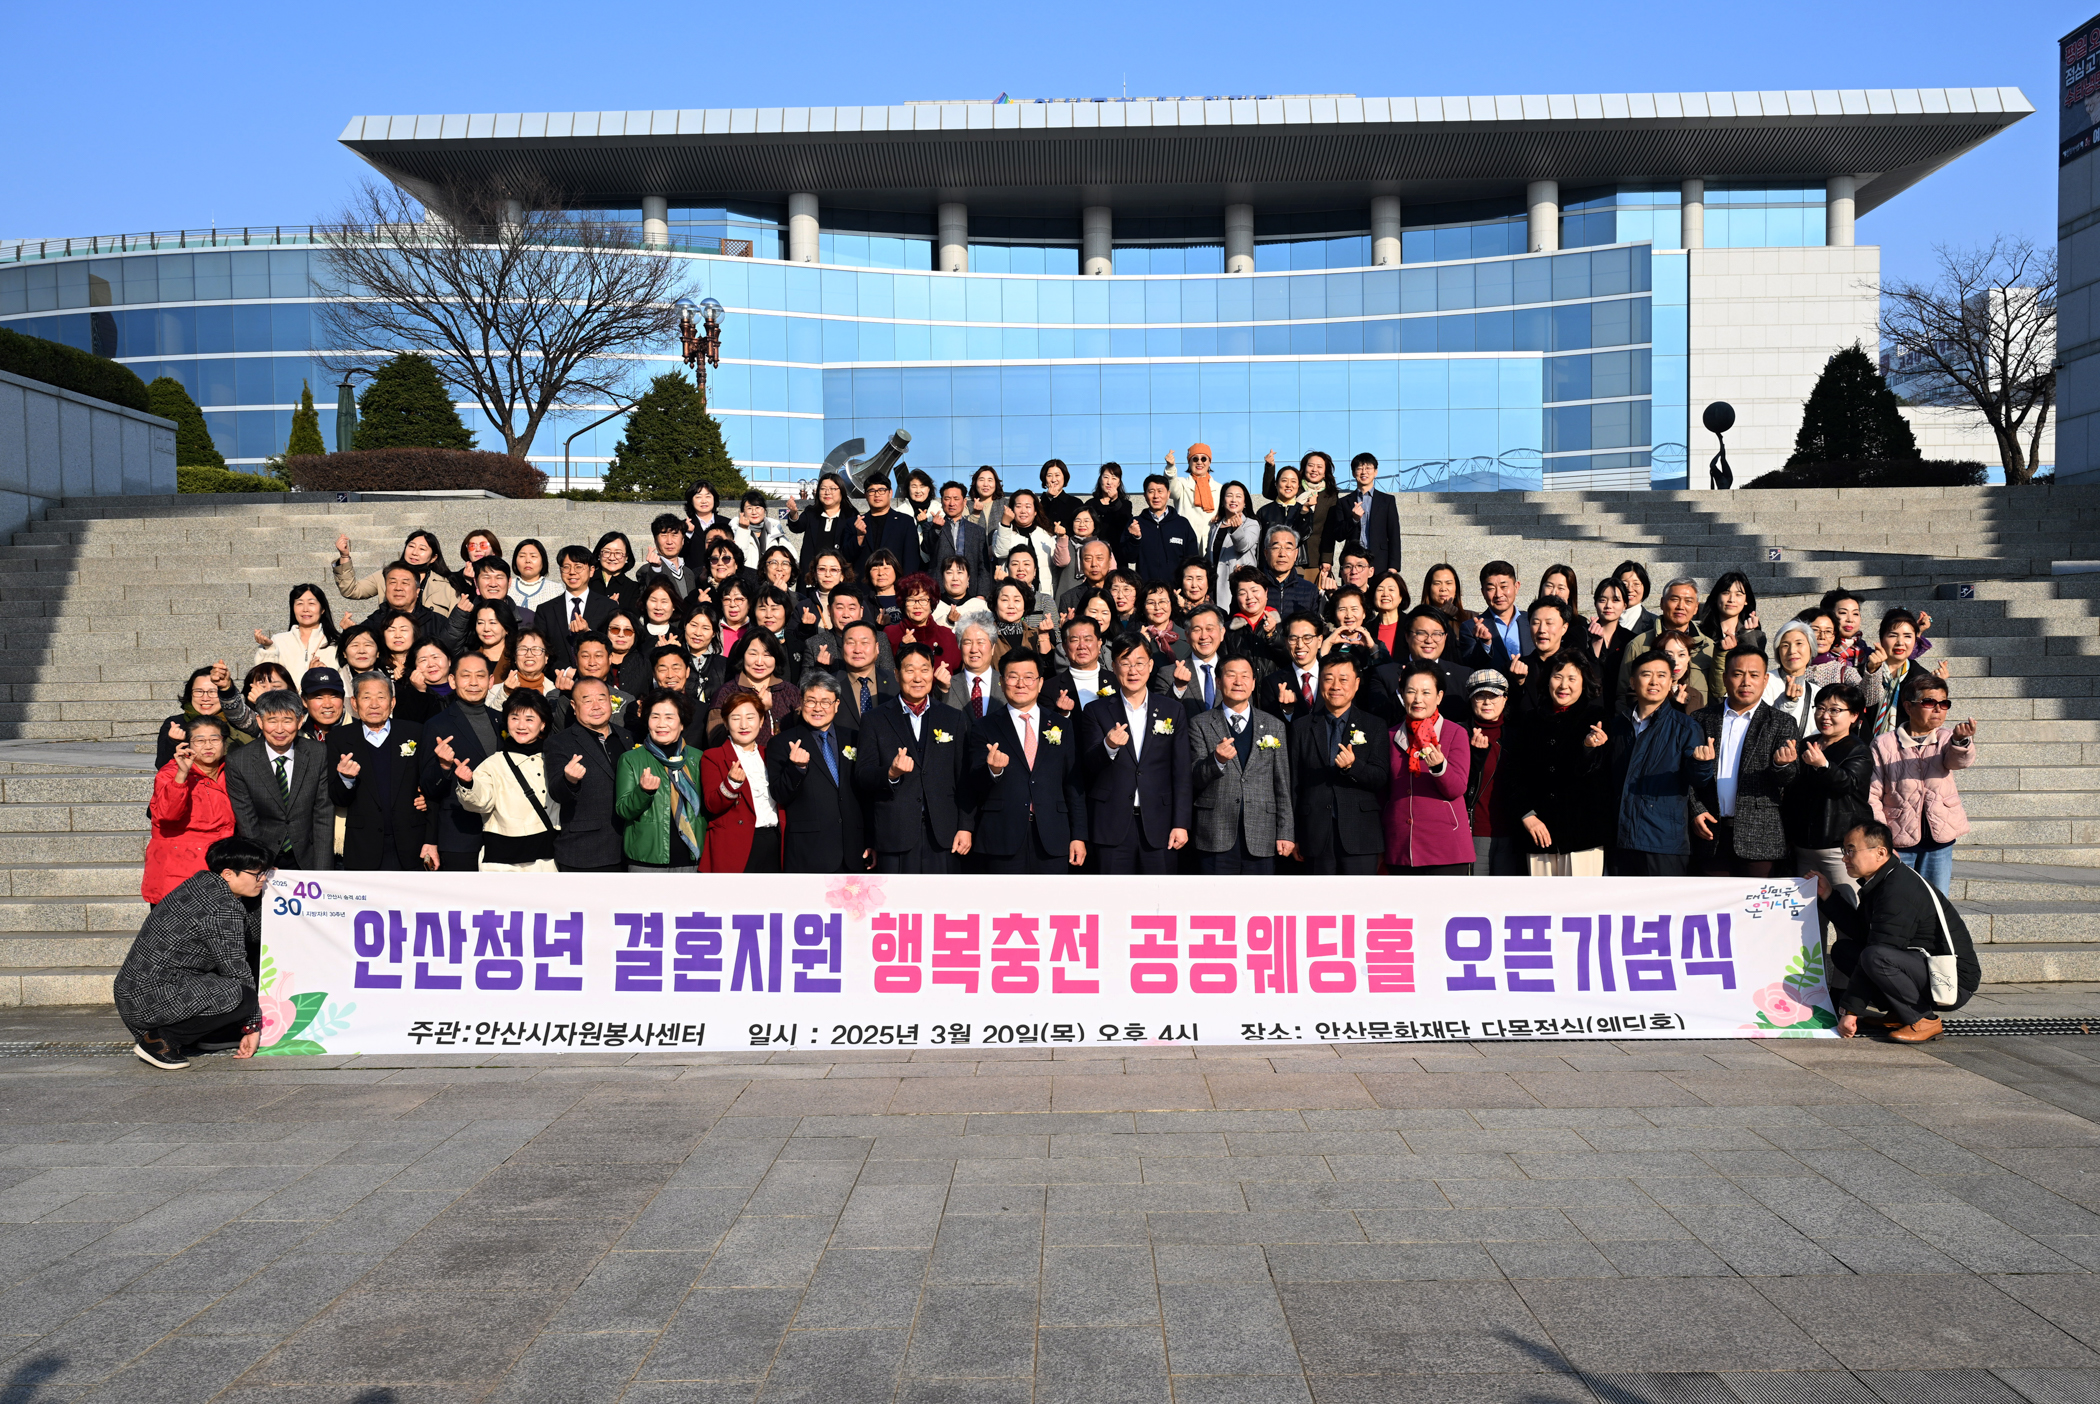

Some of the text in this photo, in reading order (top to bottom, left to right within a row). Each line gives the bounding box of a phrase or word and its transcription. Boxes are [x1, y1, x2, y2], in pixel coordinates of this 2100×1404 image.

[2065, 34, 2087, 67] 평일
[2065, 49, 2100, 87] 점심 고
[272, 879, 322, 900] 2025 40
[273, 896, 302, 916] 30
[354, 910, 1738, 994] 안산청년 결혼지원 행복충전 공공웨딩홀 오픈기념식
[407, 1020, 706, 1047] 주관:안산시자원봉사센터
[748, 1023, 798, 1046] 일시
[830, 1023, 919, 1045] 2025년
[930, 1022, 971, 1045] 3월
[982, 1022, 1086, 1044] 20일(목)
[1096, 1022, 1149, 1042] 오후
[1158, 1022, 1200, 1042] 4시
[1240, 1022, 1304, 1041] 장소:
[1315, 1020, 1471, 1040] 안산문화재단
